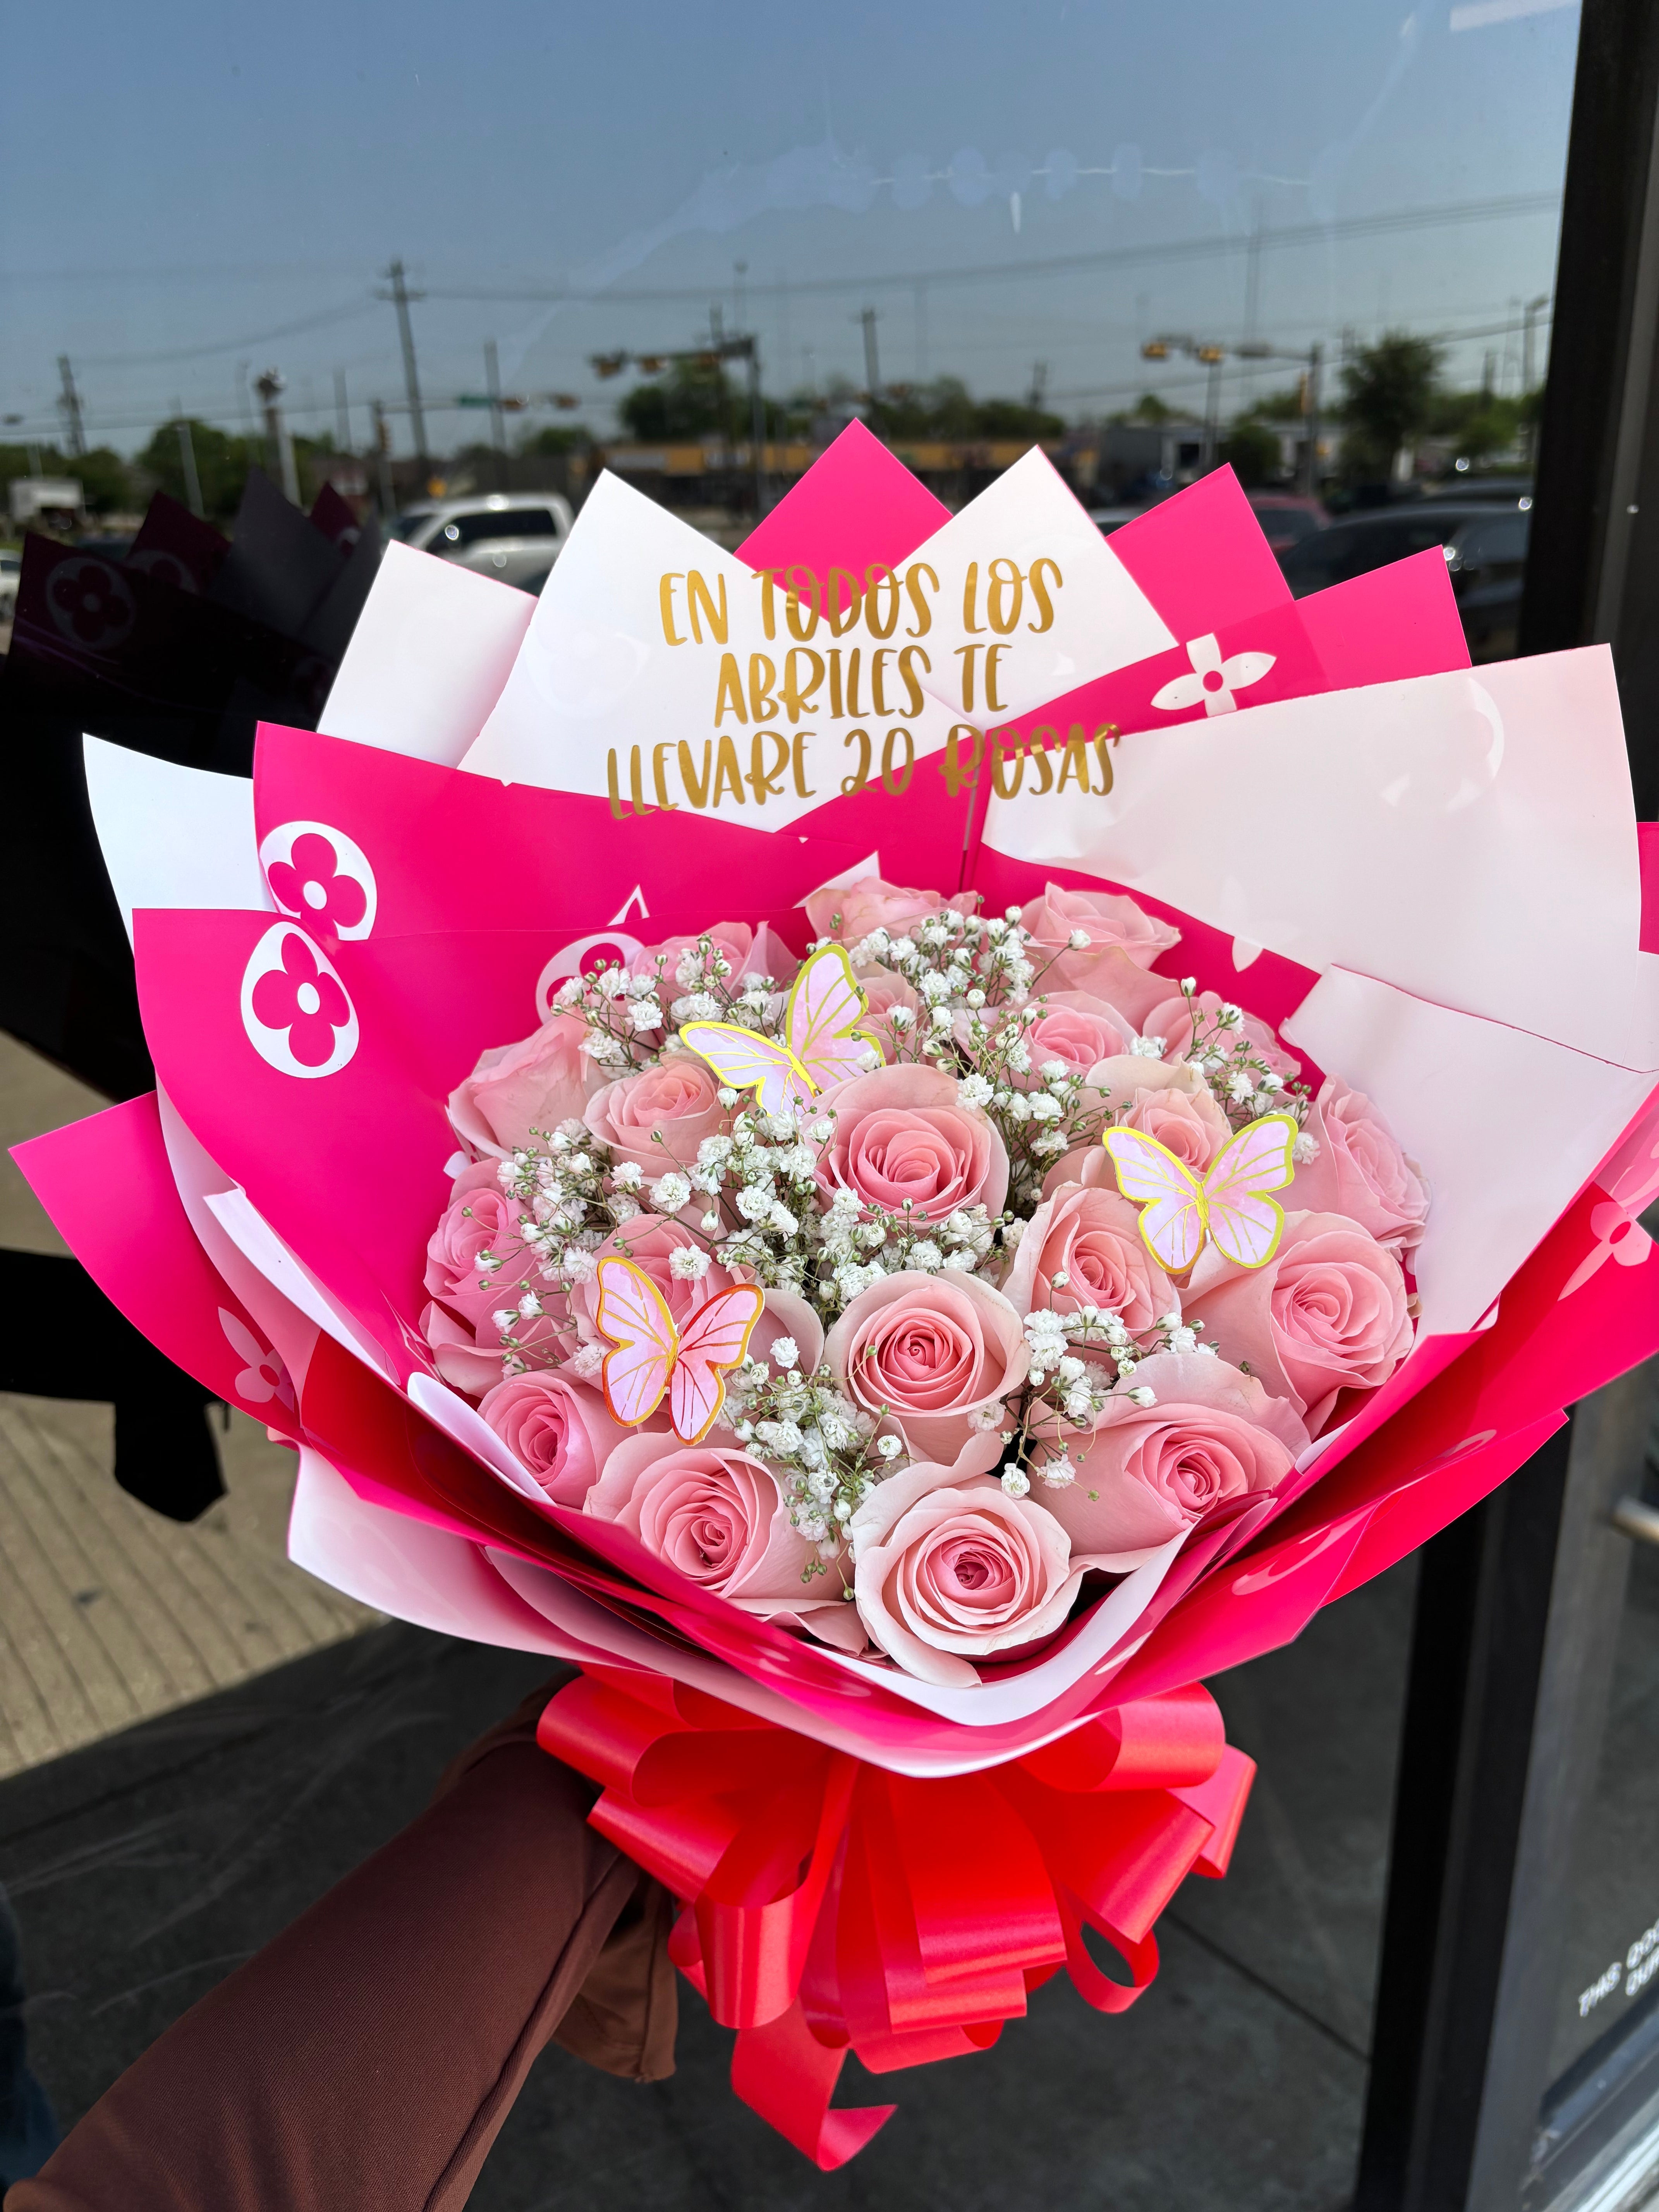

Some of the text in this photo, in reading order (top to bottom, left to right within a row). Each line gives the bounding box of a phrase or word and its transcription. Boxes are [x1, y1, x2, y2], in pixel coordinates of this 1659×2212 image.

[659, 558, 1063, 646] EN TODOS LOS
[714, 644, 1012, 727] ABRILES TE
[608, 724, 1120, 820] LLEVARE 20 ROSAS
